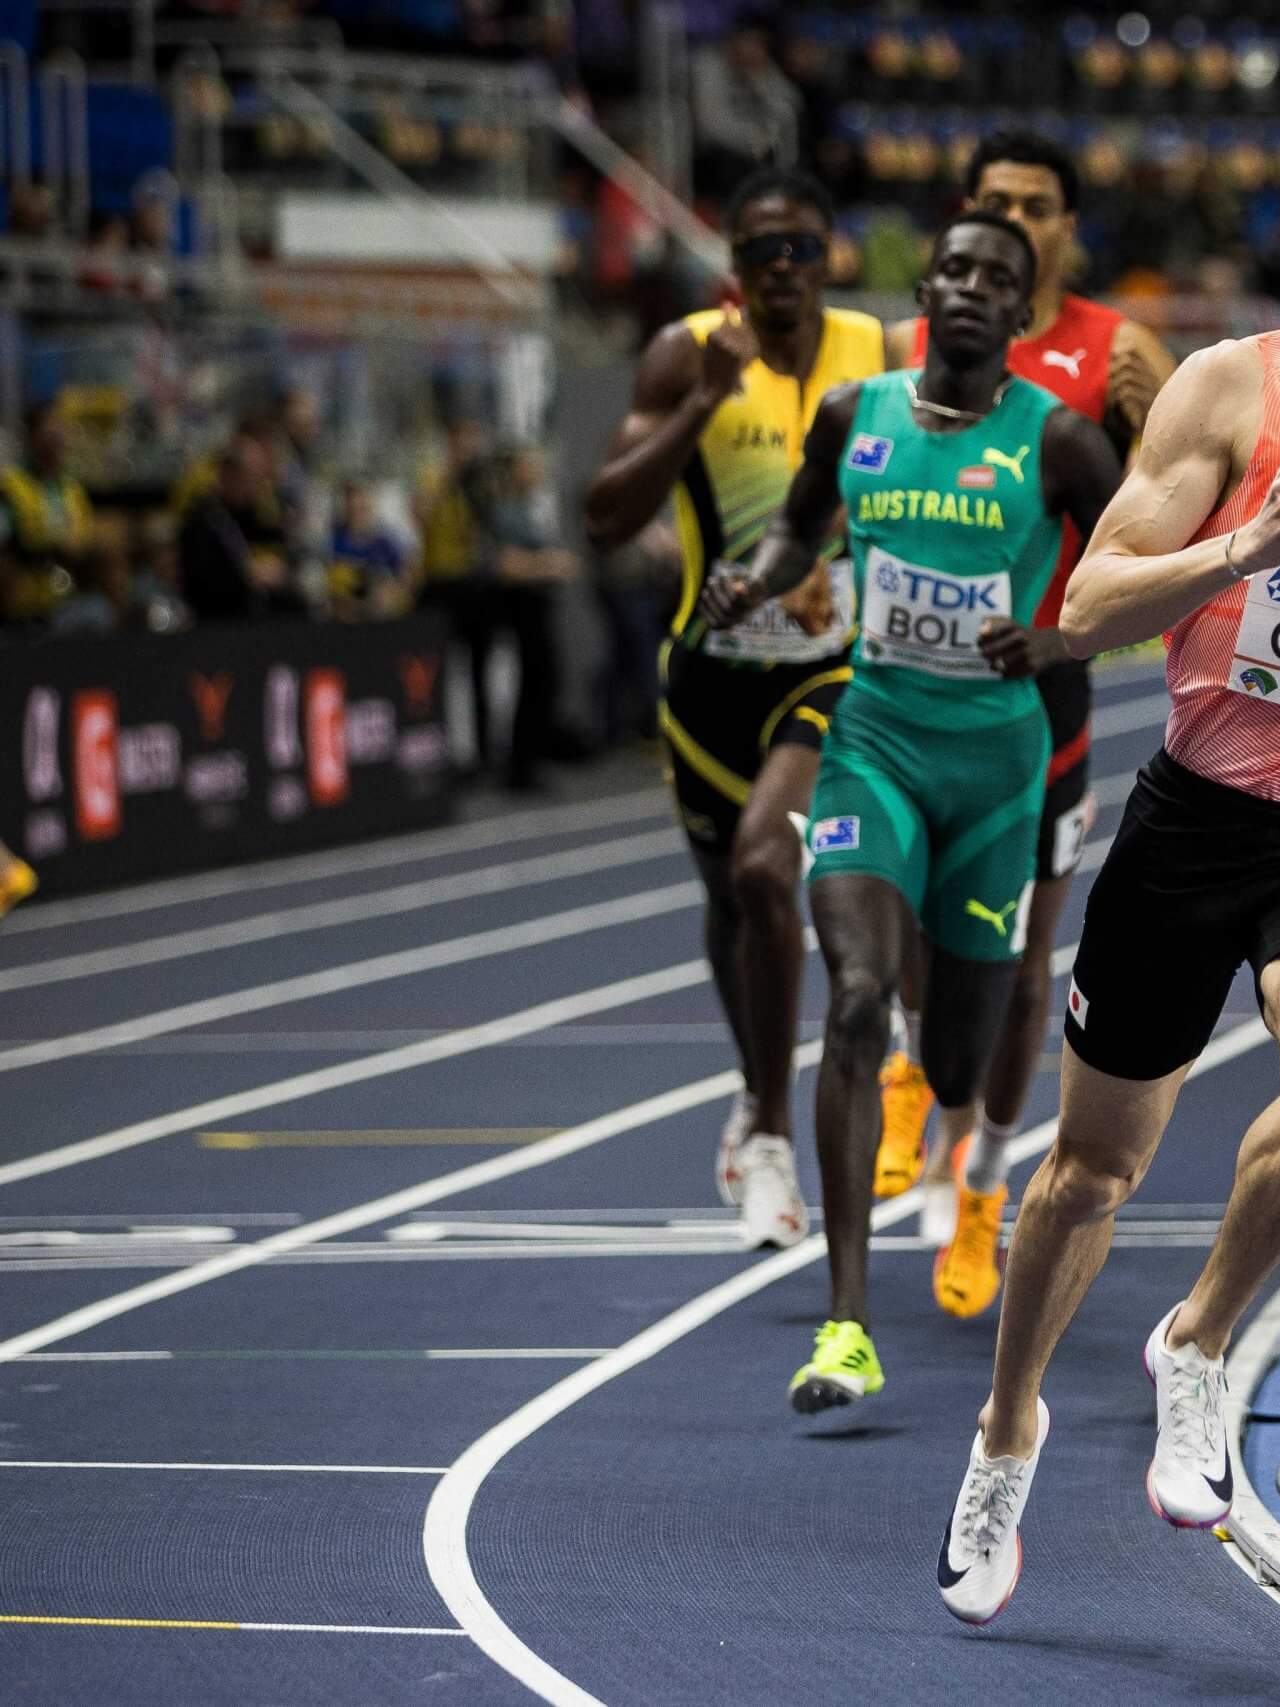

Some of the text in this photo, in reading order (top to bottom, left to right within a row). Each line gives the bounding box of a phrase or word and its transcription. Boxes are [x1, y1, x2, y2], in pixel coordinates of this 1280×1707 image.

[859, 489, 1004, 530] AUSTRALIA
[902, 568, 997, 610] TDK
[887, 605, 972, 648] BOL
